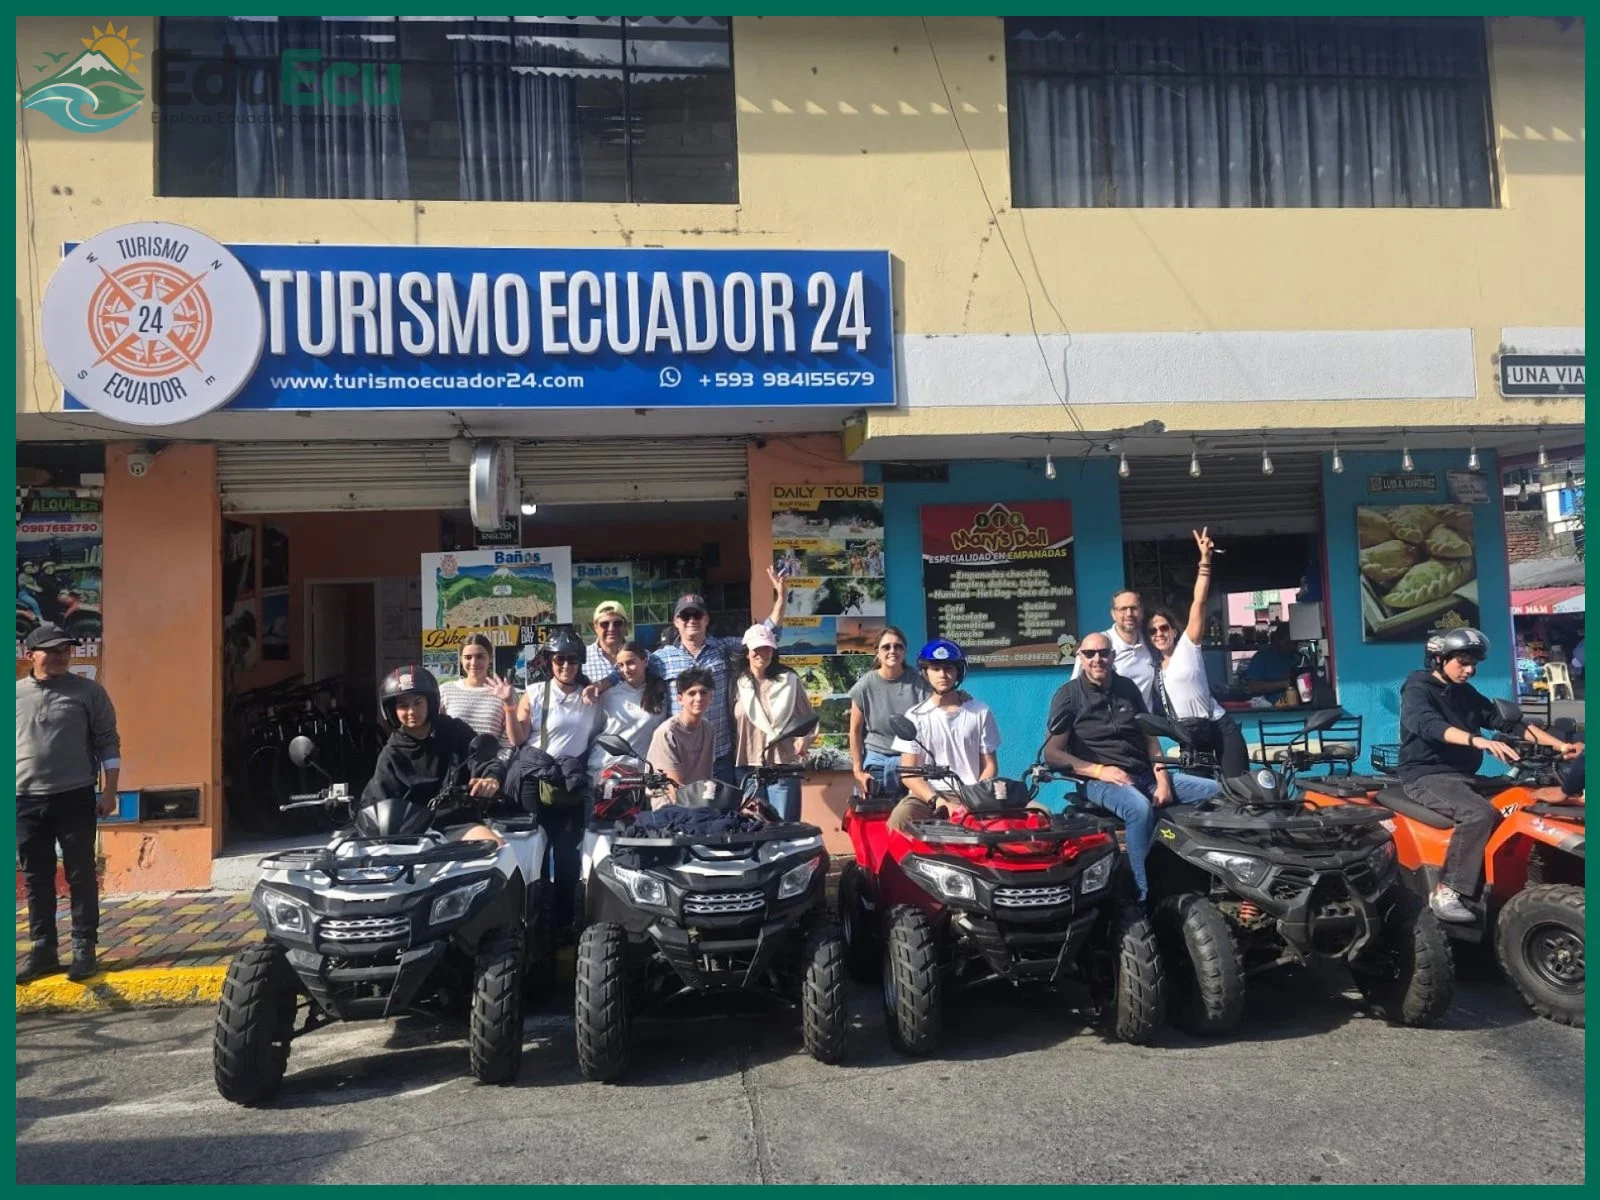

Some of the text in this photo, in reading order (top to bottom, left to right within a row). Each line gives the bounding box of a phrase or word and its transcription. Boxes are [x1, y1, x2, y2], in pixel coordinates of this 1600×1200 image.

[116, 236, 189, 263] TURISMO
[138, 306, 163, 333] 24
[260, 269, 873, 356] TURISMO ECUADOR 24
[270, 372, 584, 389] www.turismoecuador24.com
[763, 371, 875, 387] 984155679
[1513, 367, 1584, 382] UNA VIA
[103, 372, 187, 406] ECUADOR
[774, 486, 879, 498] DAILY TOURS
[951, 527, 1049, 551] Mary's Deli
[494, 551, 541, 564] Baños
[929, 548, 1067, 564] ESPECIALIDAD EN EMPANADAS
[424, 629, 467, 648] Bike
